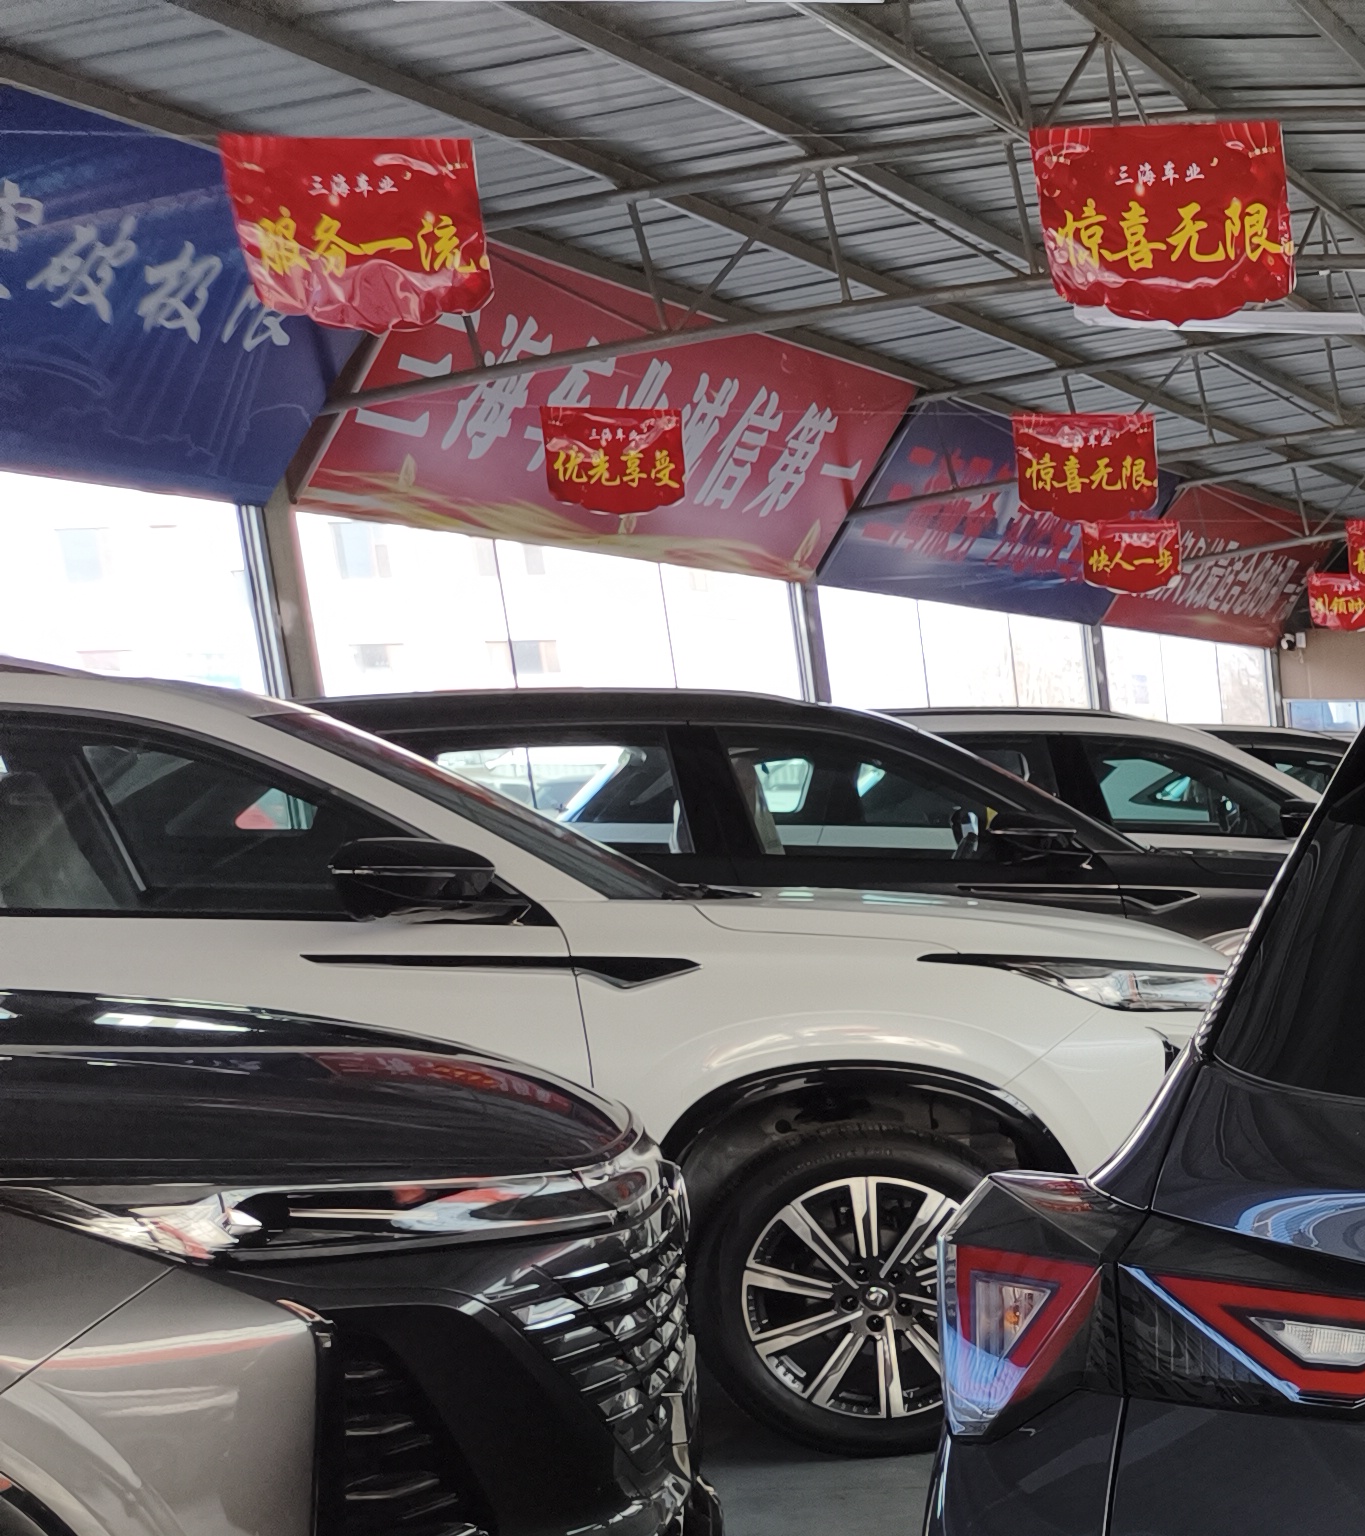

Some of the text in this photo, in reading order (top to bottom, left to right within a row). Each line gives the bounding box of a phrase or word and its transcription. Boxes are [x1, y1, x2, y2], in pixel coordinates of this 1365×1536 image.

[308, 172, 399, 198] 三海车业
[1114, 161, 1205, 187] 三海车业
[257, 212, 478, 277] 服务一流
[1056, 198, 1285, 271] 惊喜无限
[553, 448, 680, 489] 优先享受
[1025, 454, 1155, 495] 惊喜无限
[1088, 547, 1174, 576] 快人一步
